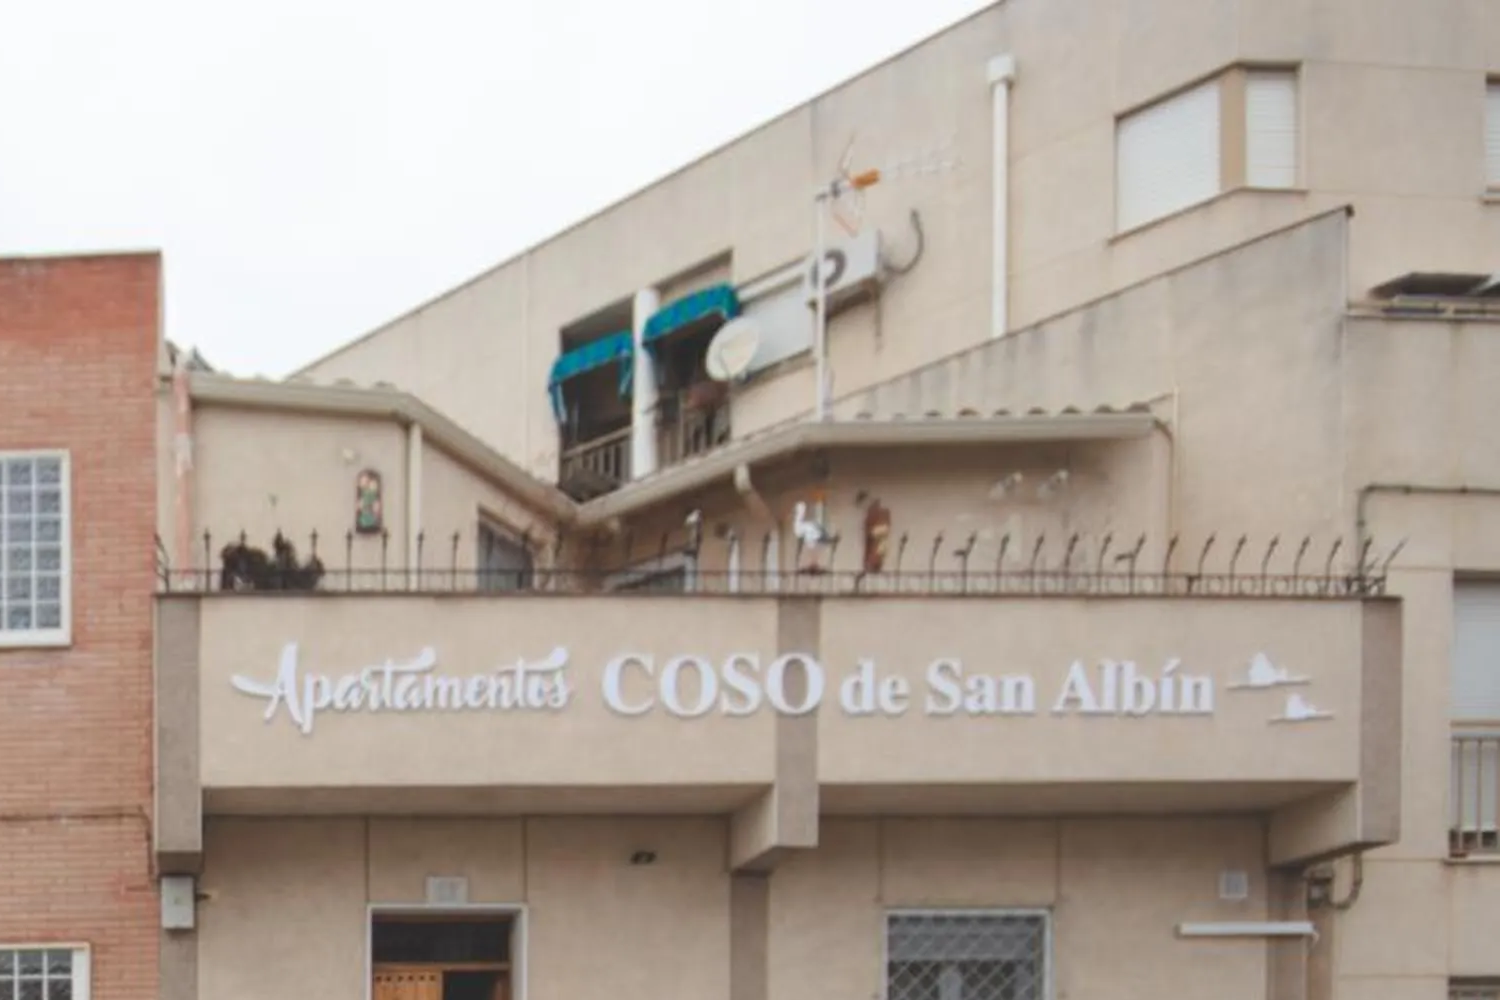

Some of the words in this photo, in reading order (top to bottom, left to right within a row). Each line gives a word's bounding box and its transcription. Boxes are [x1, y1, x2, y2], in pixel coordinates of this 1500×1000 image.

[230, 640, 572, 735] Apartamentos
[602, 652, 825, 716] COSO
[840, 656, 911, 715] de
[924, 656, 1037, 715] San
[1049, 656, 1215, 715] Albín
